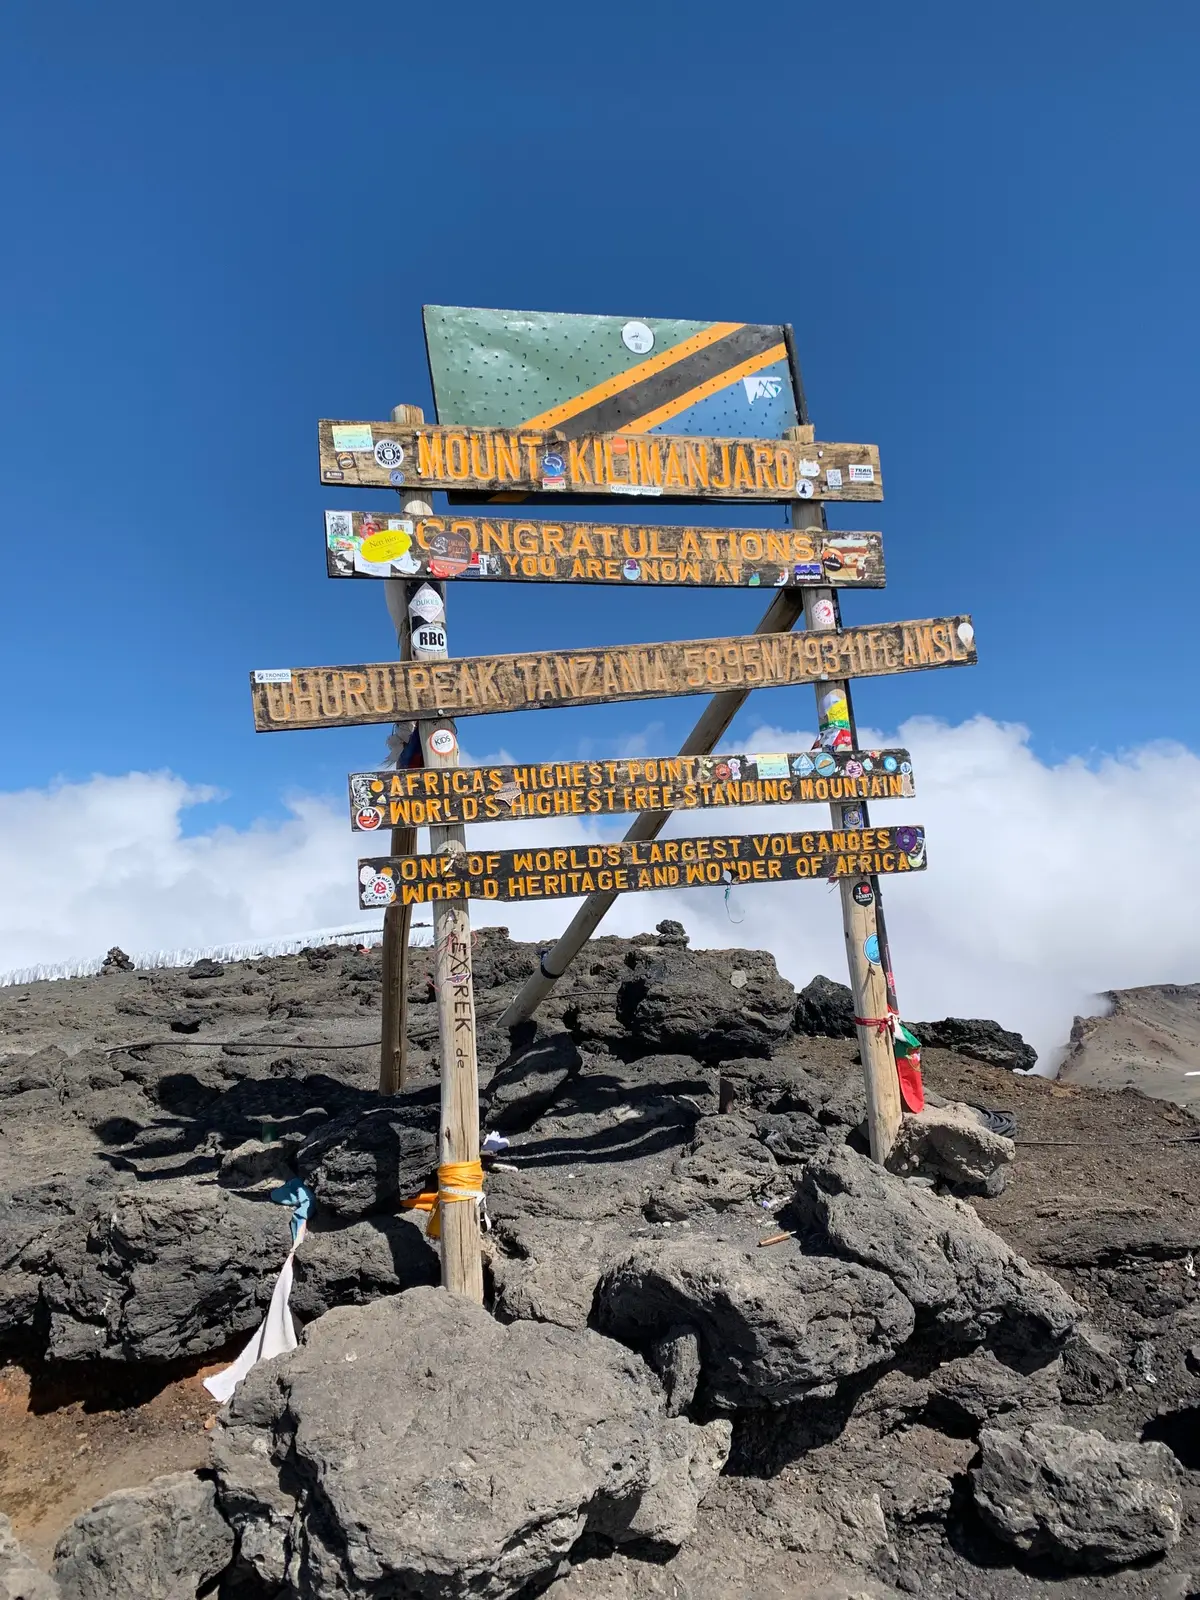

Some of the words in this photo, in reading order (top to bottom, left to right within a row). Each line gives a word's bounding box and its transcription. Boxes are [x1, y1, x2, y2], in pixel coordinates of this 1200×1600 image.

[418, 431, 543, 481] MOUNT
[569, 438, 795, 490] KILIMANJARO
[415, 518, 815, 562] CONGRATULATIONS
[505, 555, 557, 576] YOU
[571, 557, 621, 581] ARE
[641, 560, 700, 583] NOW
[716, 564, 743, 583] AT
[419, 632, 445, 647] RBC
[266, 667, 394, 721] UHURU
[902, 624, 968, 668] AMSL
[434, 735, 452, 746] KIDS
[390, 768, 503, 797] AFRICA'S
[513, 763, 617, 790] HIGHEST
[629, 759, 696, 785] POINT
[390, 794, 503, 825] WORLD'S
[511, 788, 617, 816] HIGHEST
[800, 774, 902, 801] MOUNTAIN
[401, 856, 456, 881] ONE
[468, 854, 501, 876] OF
[513, 848, 621, 873] WORLD'S
[632, 837, 742, 868] LARGEST
[508, 869, 629, 898] HERITAGE
[638, 865, 680, 888] AND
[686, 858, 783, 885] WONDER
[796, 856, 824, 878] OF
[835, 849, 911, 875] AFRICA
